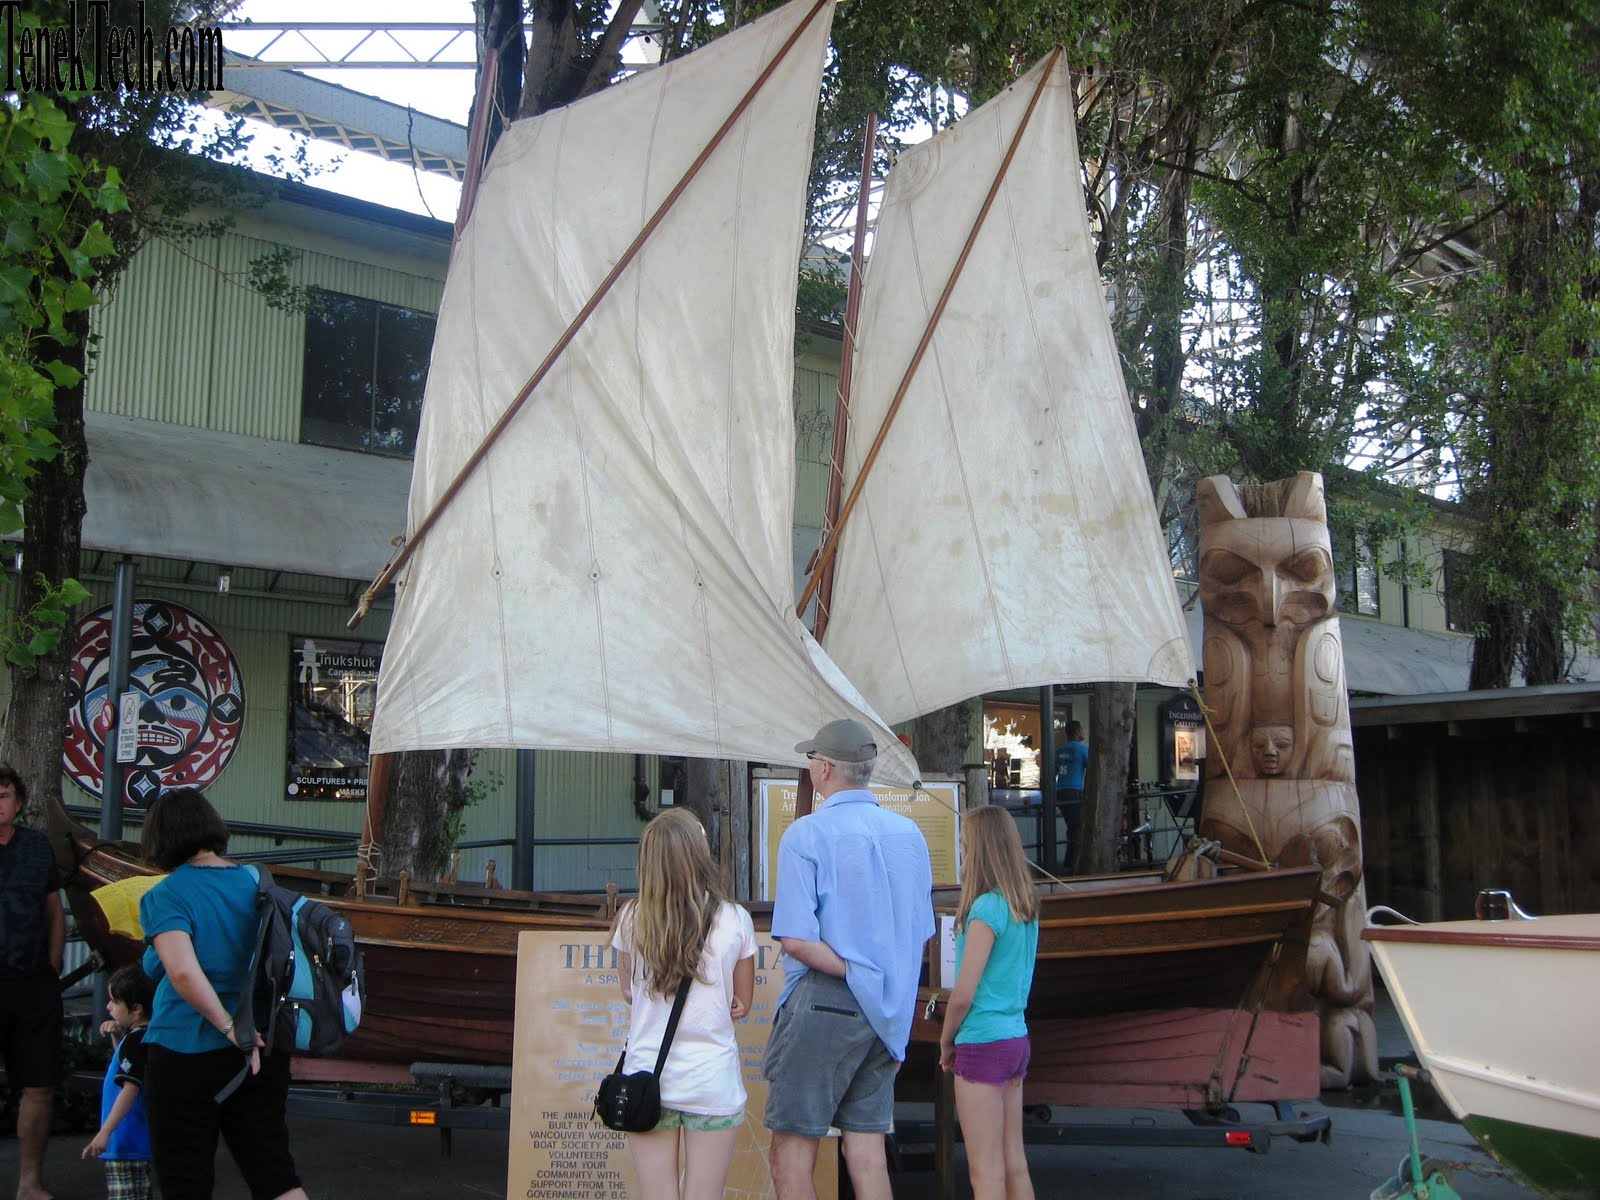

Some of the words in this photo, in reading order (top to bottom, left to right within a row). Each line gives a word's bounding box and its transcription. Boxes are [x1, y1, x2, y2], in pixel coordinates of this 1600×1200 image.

[320, 654, 376, 668] inukshuk
[296, 776, 346, 786] SCULPTURES
[339, 787, 365, 796] MASKS
[781, 789, 797, 800] Tre
[585, 975, 593, 985] A
[599, 975, 619, 985] SPA
[755, 976, 768, 985] 91
[541, 1111, 559, 1120] THE
[563, 1111, 590, 1120] JUANIT
[548, 1121, 573, 1130] BUILT
[576, 1122, 589, 1130] BY
[529, 1131, 585, 1140] VANCOUVER
[533, 1140, 557, 1149] BOAT
[561, 1141, 602, 1150] SOCIETY
[605, 1141, 625, 1150] AND
[548, 1151, 609, 1160] VOLUNTEERS
[550, 1160, 577, 1169] FROM
[581, 1160, 606, 1169] YOUR
[536, 1170, 593, 1179] COMMUNITY
[597, 1171, 620, 1180] WITH
[530, 1180, 573, 1189] SUPPORT
[577, 1181, 604, 1190] FROM
[608, 1181, 626, 1190] THE
[526, 1190, 590, 1200] GOVERNMENT
[594, 1190, 607, 1200] OF
